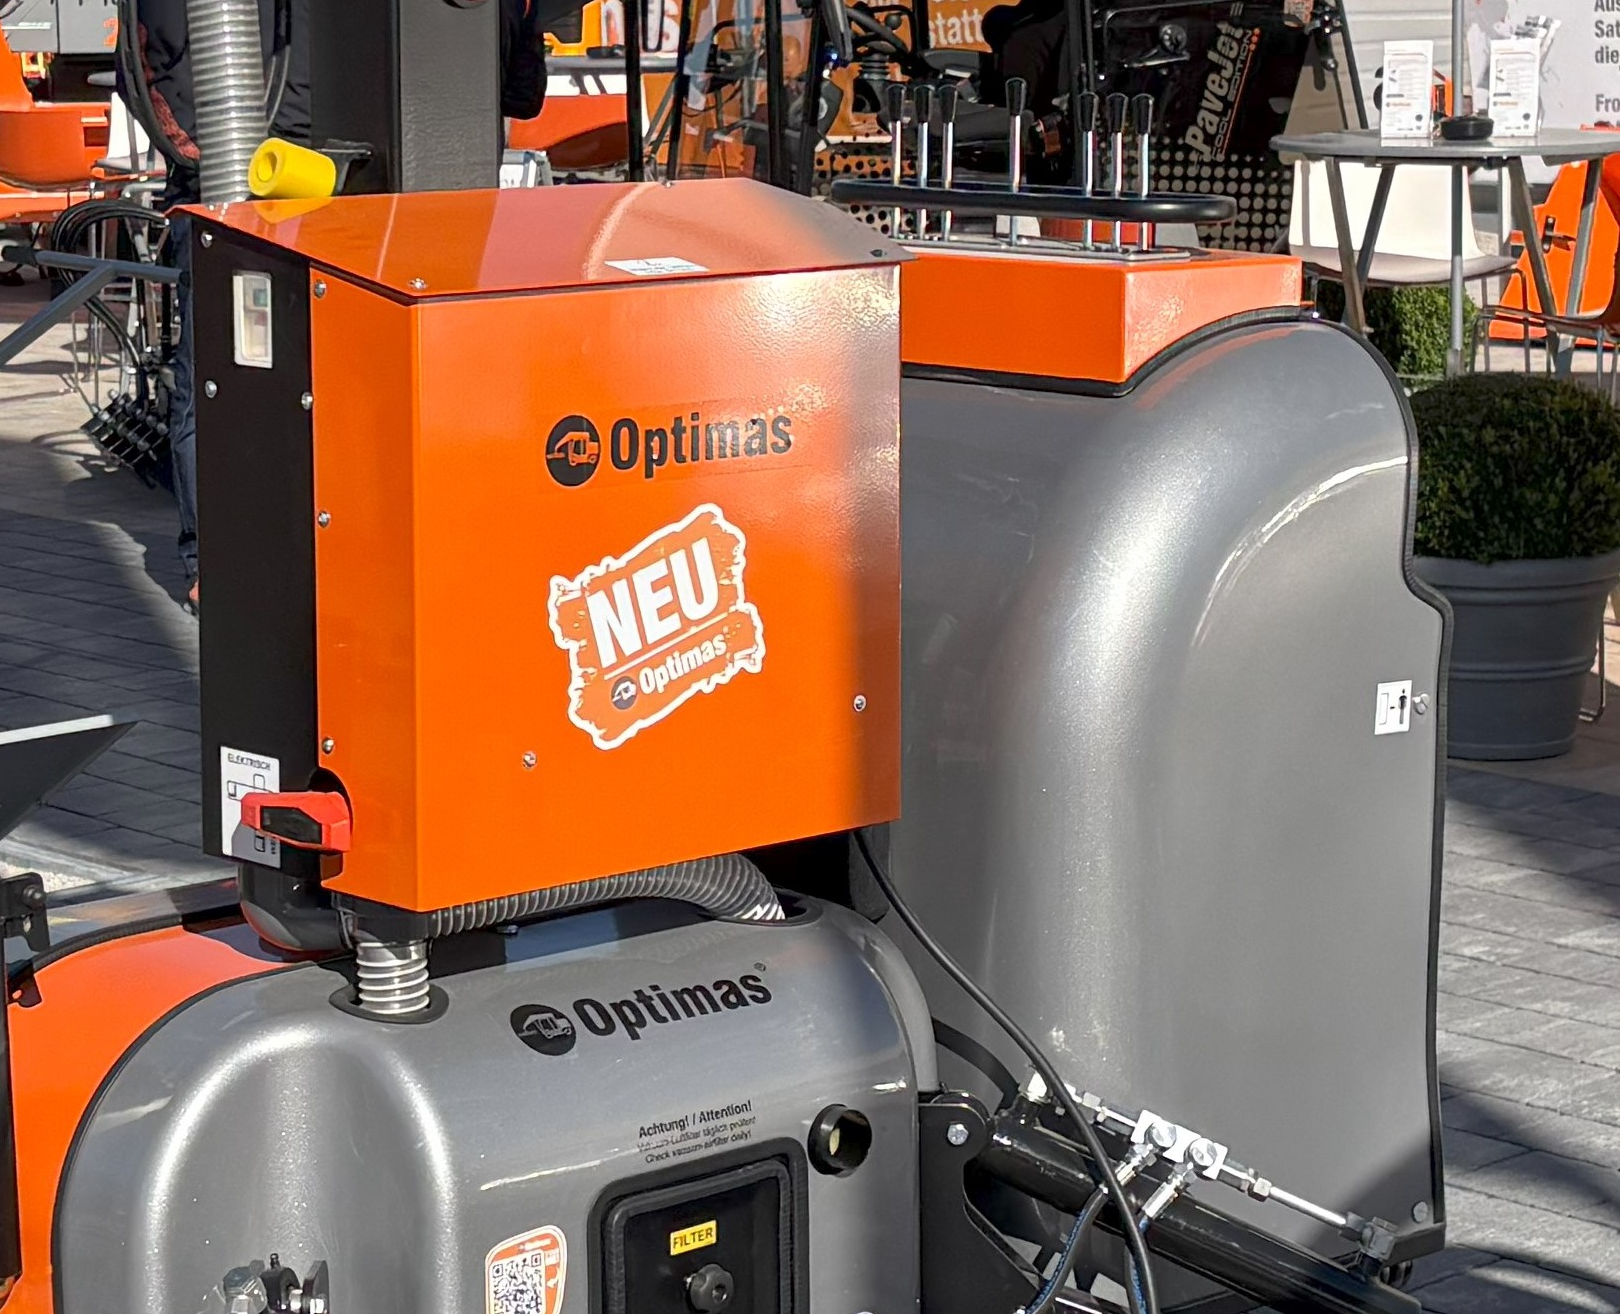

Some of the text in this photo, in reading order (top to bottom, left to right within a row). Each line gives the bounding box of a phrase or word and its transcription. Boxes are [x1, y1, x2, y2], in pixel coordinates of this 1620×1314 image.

[1594, 20, 1620, 39] Sat
[1228, 30, 1253, 103] EDITION
[1594, 93, 1620, 113] Fro
[609, 410, 793, 480] Optimas
[586, 537, 722, 667] NEU
[637, 631, 728, 696] Optimas
[638, 1115, 689, 1140] Achtung!
[699, 1099, 753, 1124] Attention!
[673, 1225, 715, 1249] FILTER
